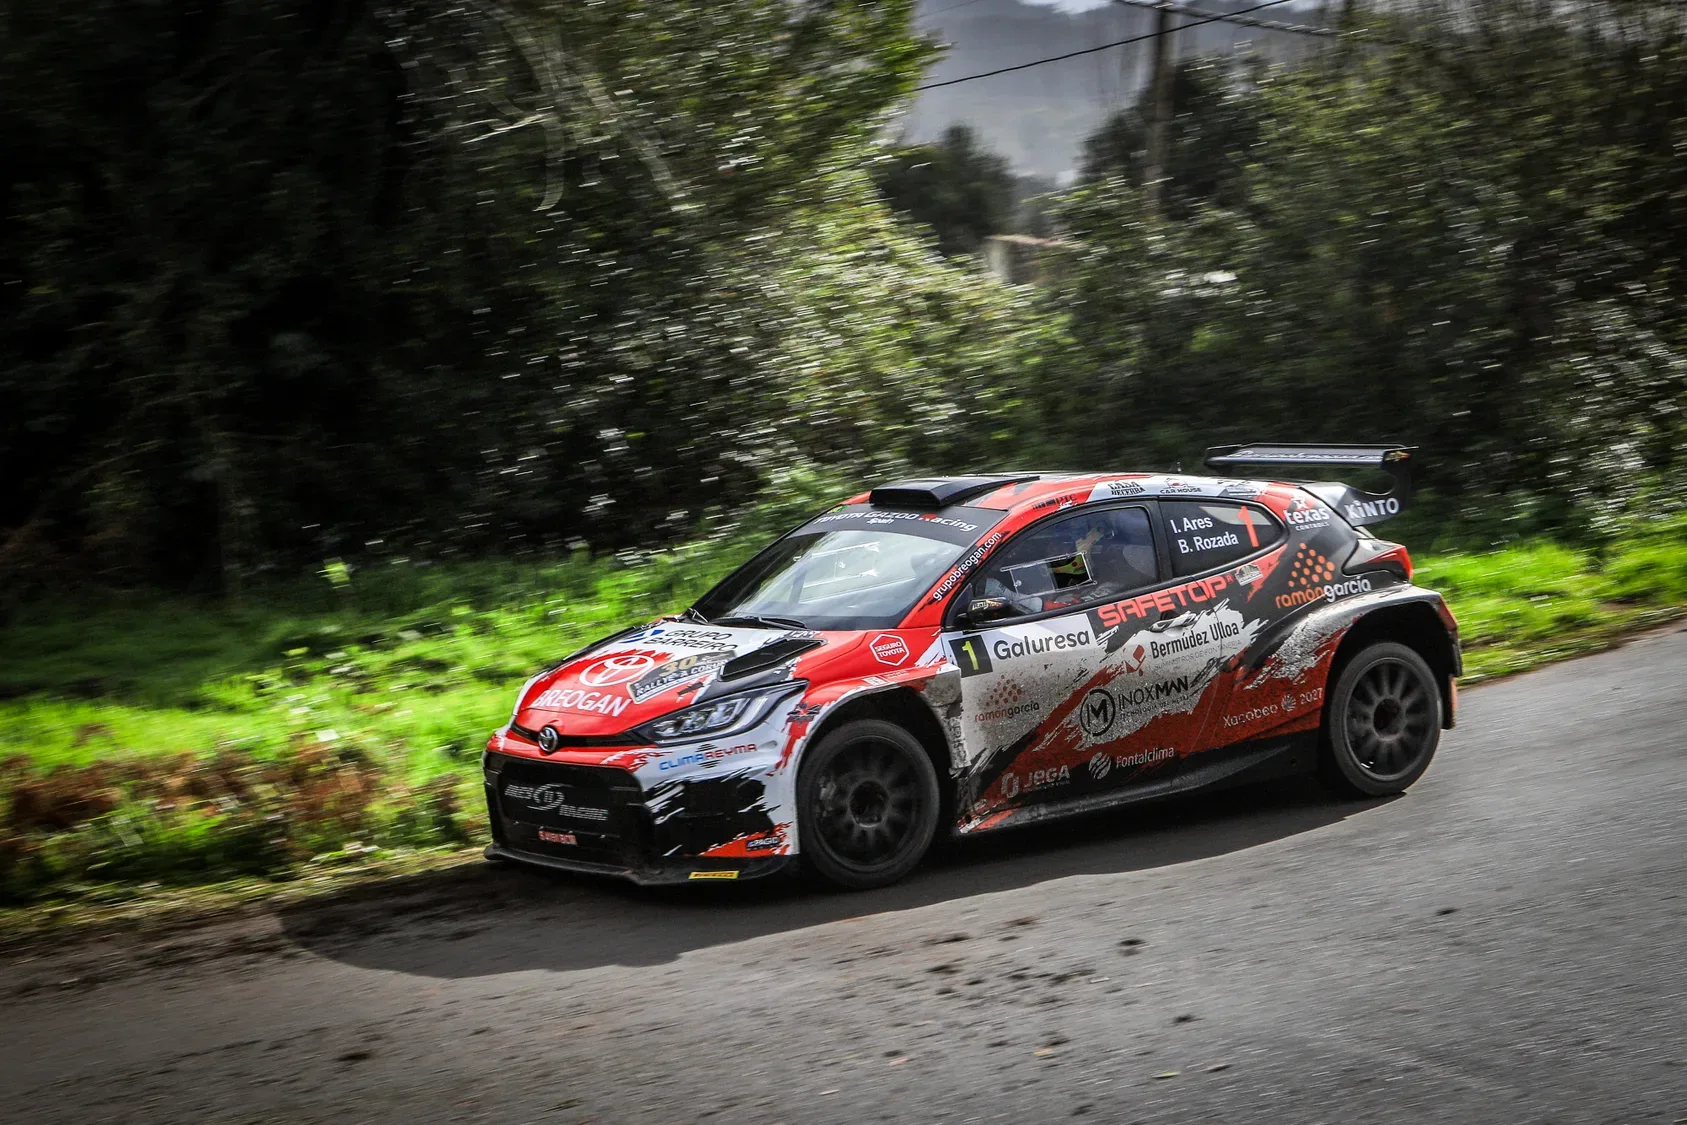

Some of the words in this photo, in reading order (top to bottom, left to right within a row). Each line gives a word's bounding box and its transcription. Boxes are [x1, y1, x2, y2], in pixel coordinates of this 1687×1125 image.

[864, 511, 919, 520] GAZOO
[918, 513, 978, 532] Racing
[1183, 515, 1213, 532] Ares
[1237, 505, 1260, 548] 1
[1283, 507, 1330, 525] texas
[1179, 540, 1194, 554] B.
[1195, 532, 1239, 550] Rozada
[932, 532, 1002, 602] grupobreogan.com
[1097, 575, 1228, 627] SAFETOP
[643, 639, 738, 652] BARREIRO
[665, 630, 732, 640] GRUPO
[874, 641, 902, 652] SEGURO
[993, 629, 1091, 660] Galuresa
[1150, 630, 1210, 659] Bermúdez
[1209, 621, 1240, 642] Ulloa
[879, 647, 905, 658] TOYOTA
[961, 640, 979, 671] 1
[660, 655, 698, 677] 30
[636, 672, 679, 697] RALLYE
[1118, 675, 1189, 711] INOXMAN
[533, 690, 632, 718] BREOGAN
[1223, 704, 1278, 728] Xacobeo
[659, 744, 758, 771] CLIMAREYMA
[1115, 747, 1175, 769] Fontalclima
